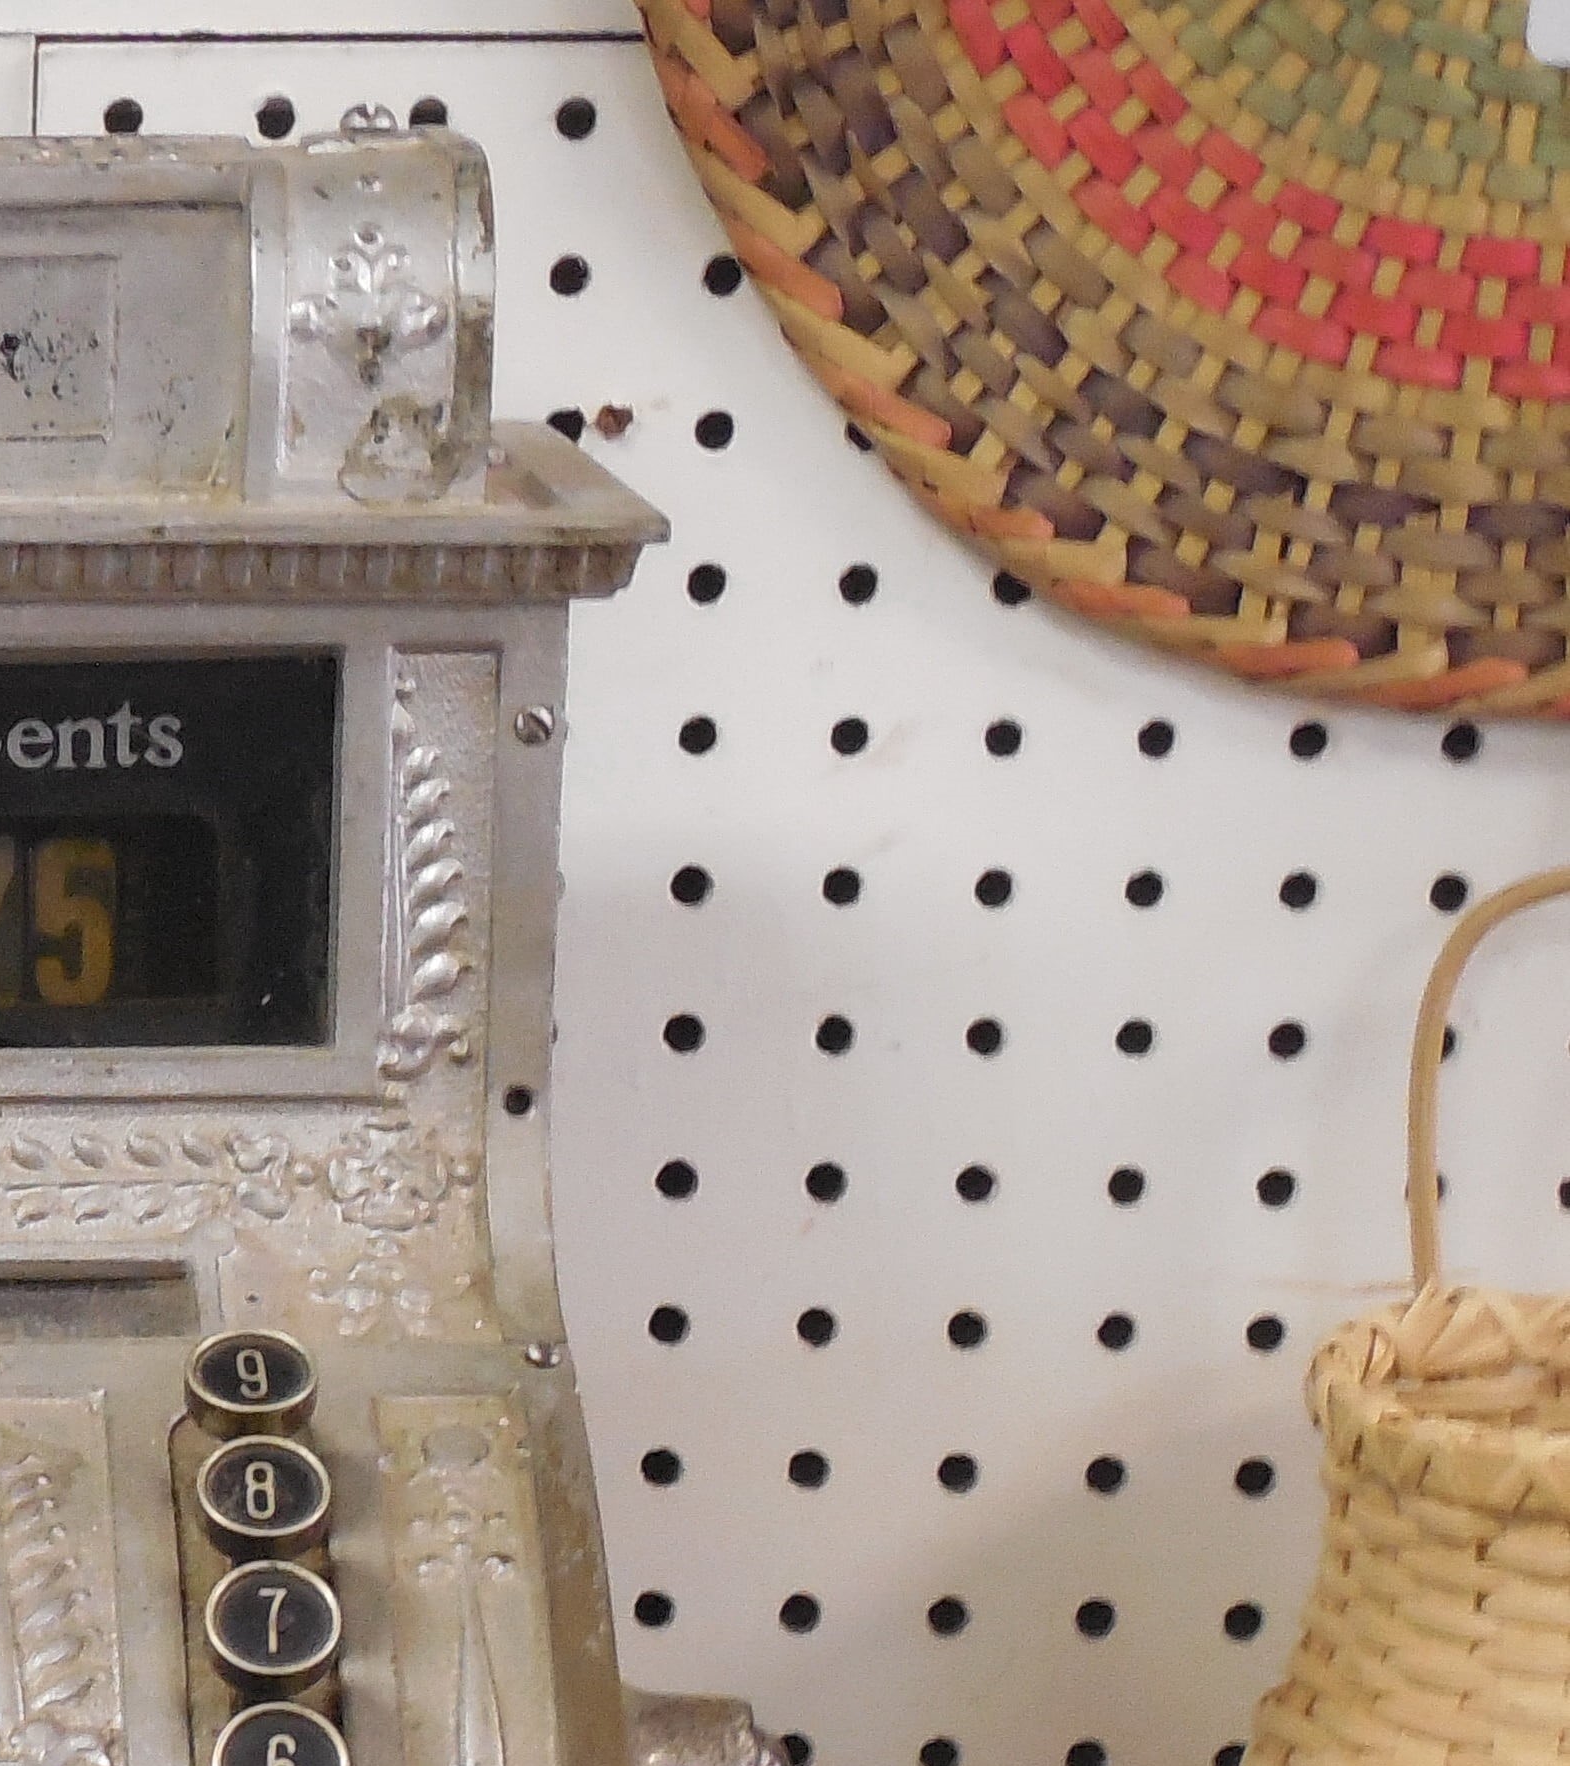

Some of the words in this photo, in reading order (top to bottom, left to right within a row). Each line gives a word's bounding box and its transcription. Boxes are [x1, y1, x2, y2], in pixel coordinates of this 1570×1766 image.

[235, 1347, 270, 1400] 9
[244, 1460, 277, 1520] 8
[259, 1587, 288, 1655] 7
